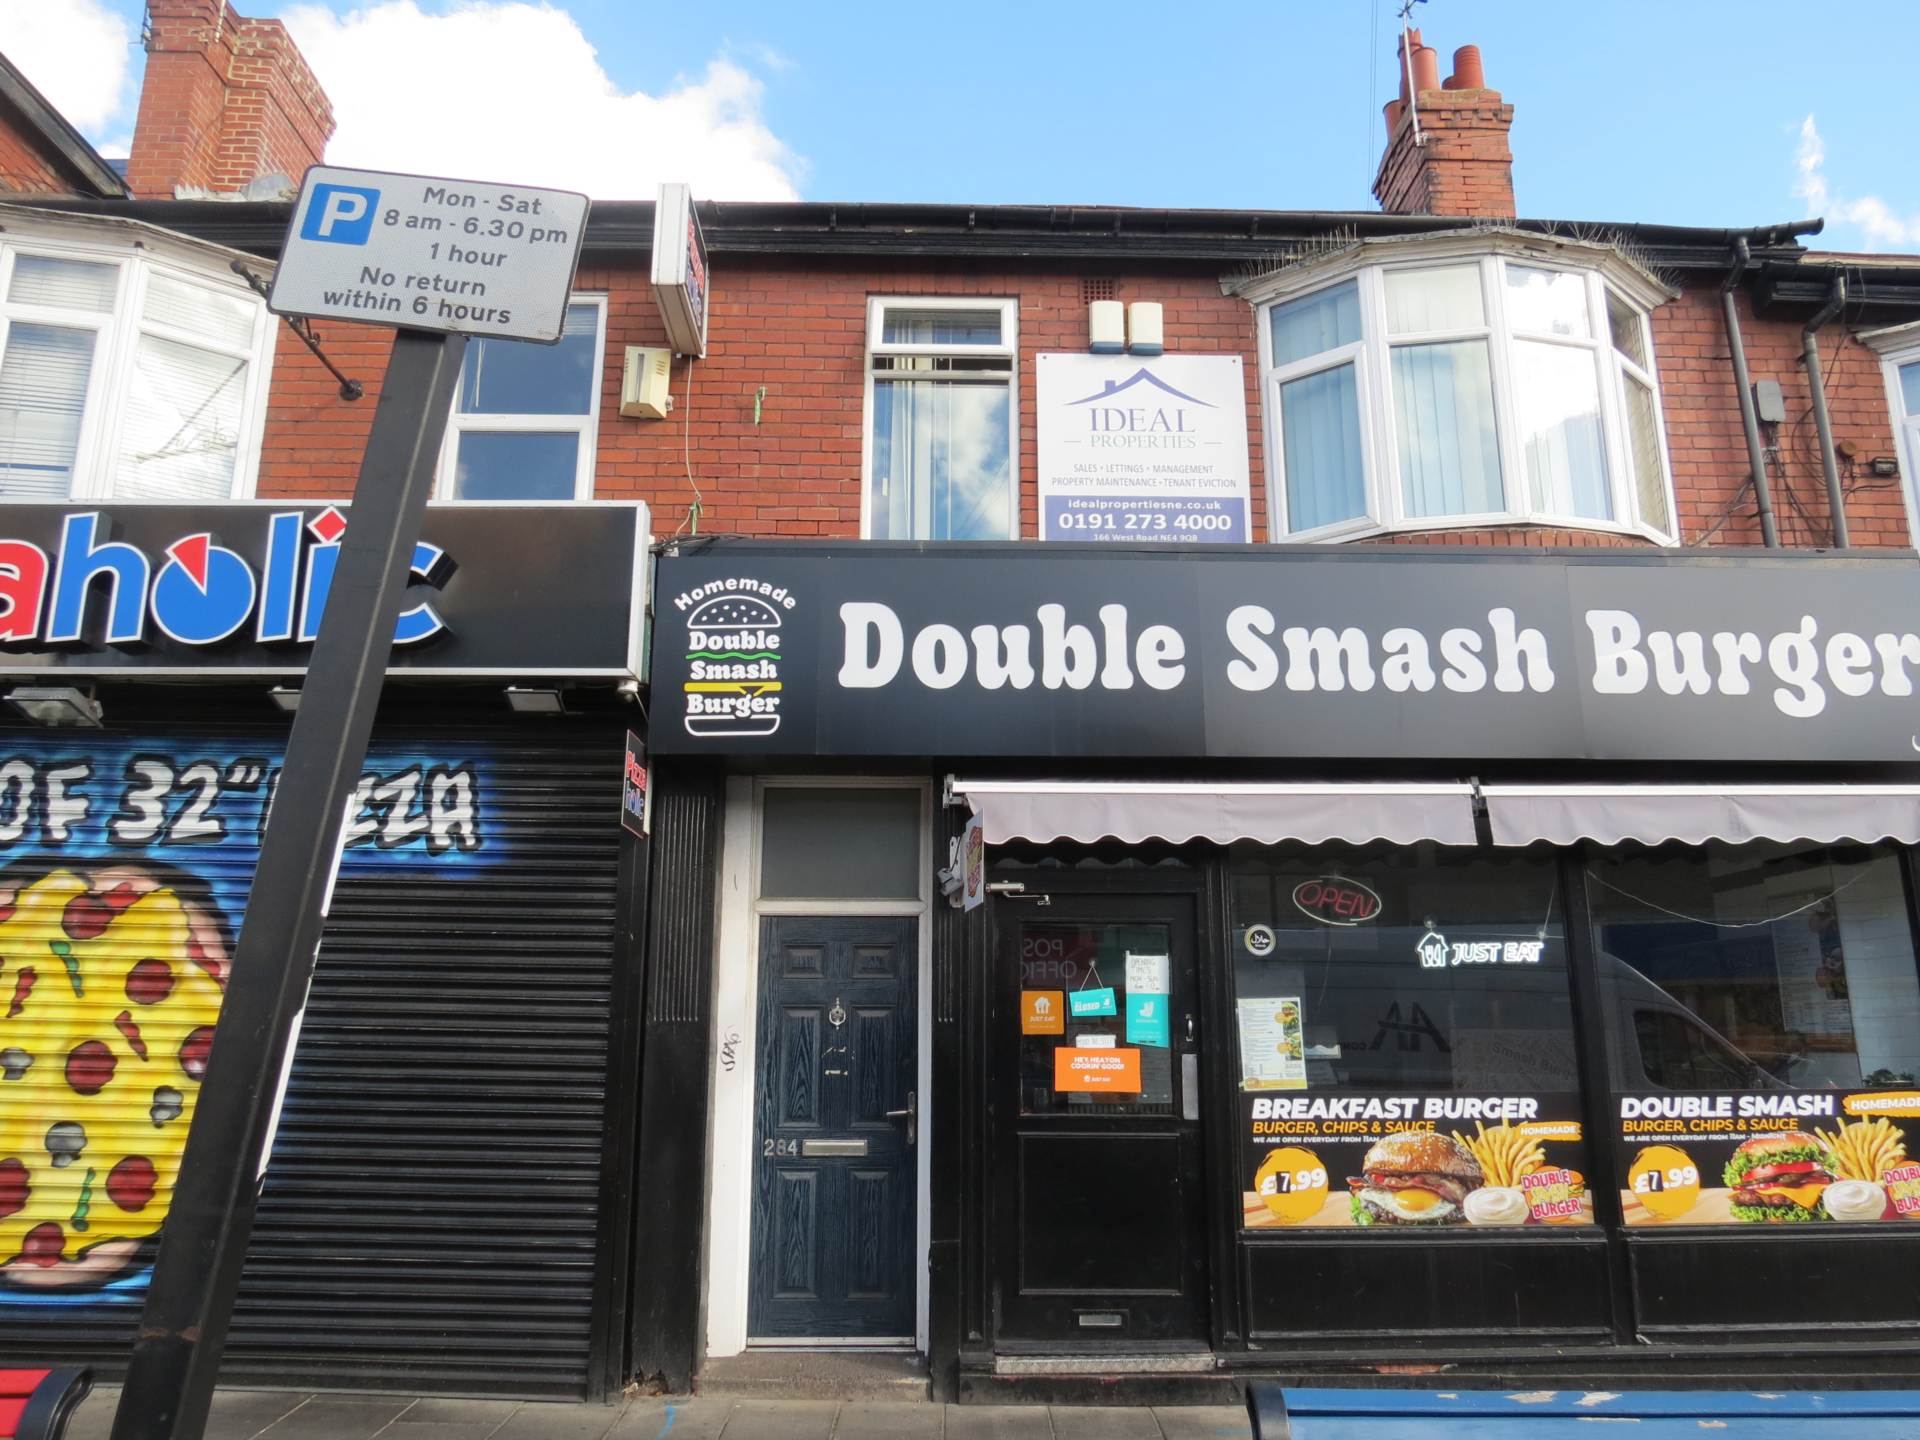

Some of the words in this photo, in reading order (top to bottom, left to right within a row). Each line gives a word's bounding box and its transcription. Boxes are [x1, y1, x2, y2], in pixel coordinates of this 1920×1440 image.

[423, 187, 475, 208] Mon
[499, 194, 542, 215] Sat
[318, 191, 368, 237] P
[383, 208, 399, 226] 8
[405, 213, 442, 231] am
[463, 216, 524, 239] 6.30
[529, 225, 568, 244] pm
[430, 242, 440, 260] 1
[449, 245, 508, 267] hour
[360, 266, 395, 287] No
[405, 272, 486, 296] return
[323, 290, 401, 312] within
[412, 295, 428, 315] 6
[438, 303, 511, 324] hours
[1088, 408, 1196, 433] IDEAL
[1090, 434, 1197, 449] PROPERTIES
[1073, 464, 1098, 474] SALES
[1106, 464, 1144, 474] LETTINGS
[1152, 465, 1214, 474] MANAGEMENT
[1051, 477, 1094, 487] PROPERTY
[1096, 478, 1158, 488] MAINTENANCE
[1164, 478, 1197, 488] TENANT
[1198, 479, 1237, 488] EVICTION
[1068, 499, 1222, 513] idealpropertiesne.co.uk
[1058, 513, 1117, 530] 0191
[1124, 514, 1167, 530] 273
[1174, 514, 1232, 531] 4000
[1112, 534, 1134, 542] West
[1136, 534, 1158, 542] Road
[674, 578, 797, 611] Homemade
[688, 630, 780, 650] Double
[690, 659, 778, 680] Smash
[838, 601, 1186, 690] Double
[1225, 604, 1555, 692] Smash
[1585, 609, 1920, 718] Burger
[686, 693, 780, 718] Burger
[0, 758, 94, 845] OF
[1300, 882, 1376, 918] OPEN
[1451, 943, 1500, 966] JUST
[1503, 942, 1545, 963] EAT
[1251, 1097, 1420, 1120] BREAKFAST
[1423, 1098, 1538, 1119] BURGER
[1620, 1096, 1733, 1118] DOUBLE
[1738, 1095, 1833, 1116] SMASH
[1252, 1121, 1319, 1135] BURGER,
[1322, 1121, 1368, 1134] CHIPS
[1371, 1121, 1381, 1134] &
[1384, 1120, 1436, 1134] SAUCE
[1520, 1126, 1577, 1135] HOMEMADE
[1622, 1119, 1687, 1133] BURGER,
[1690, 1119, 1733, 1131] CHIPS
[1737, 1119, 1747, 1131] &
[1750, 1118, 1799, 1131] SAUCE
[764, 1139, 798, 1157] 284
[1672, 1134, 1707, 1142] EVERYDAY
[1260, 1168, 1328, 1196] £7.99
[1521, 1169, 1571, 1191] DOUBLE
[1635, 1166, 1699, 1193] £7.99
[1532, 1198, 1581, 1219] BURGER
